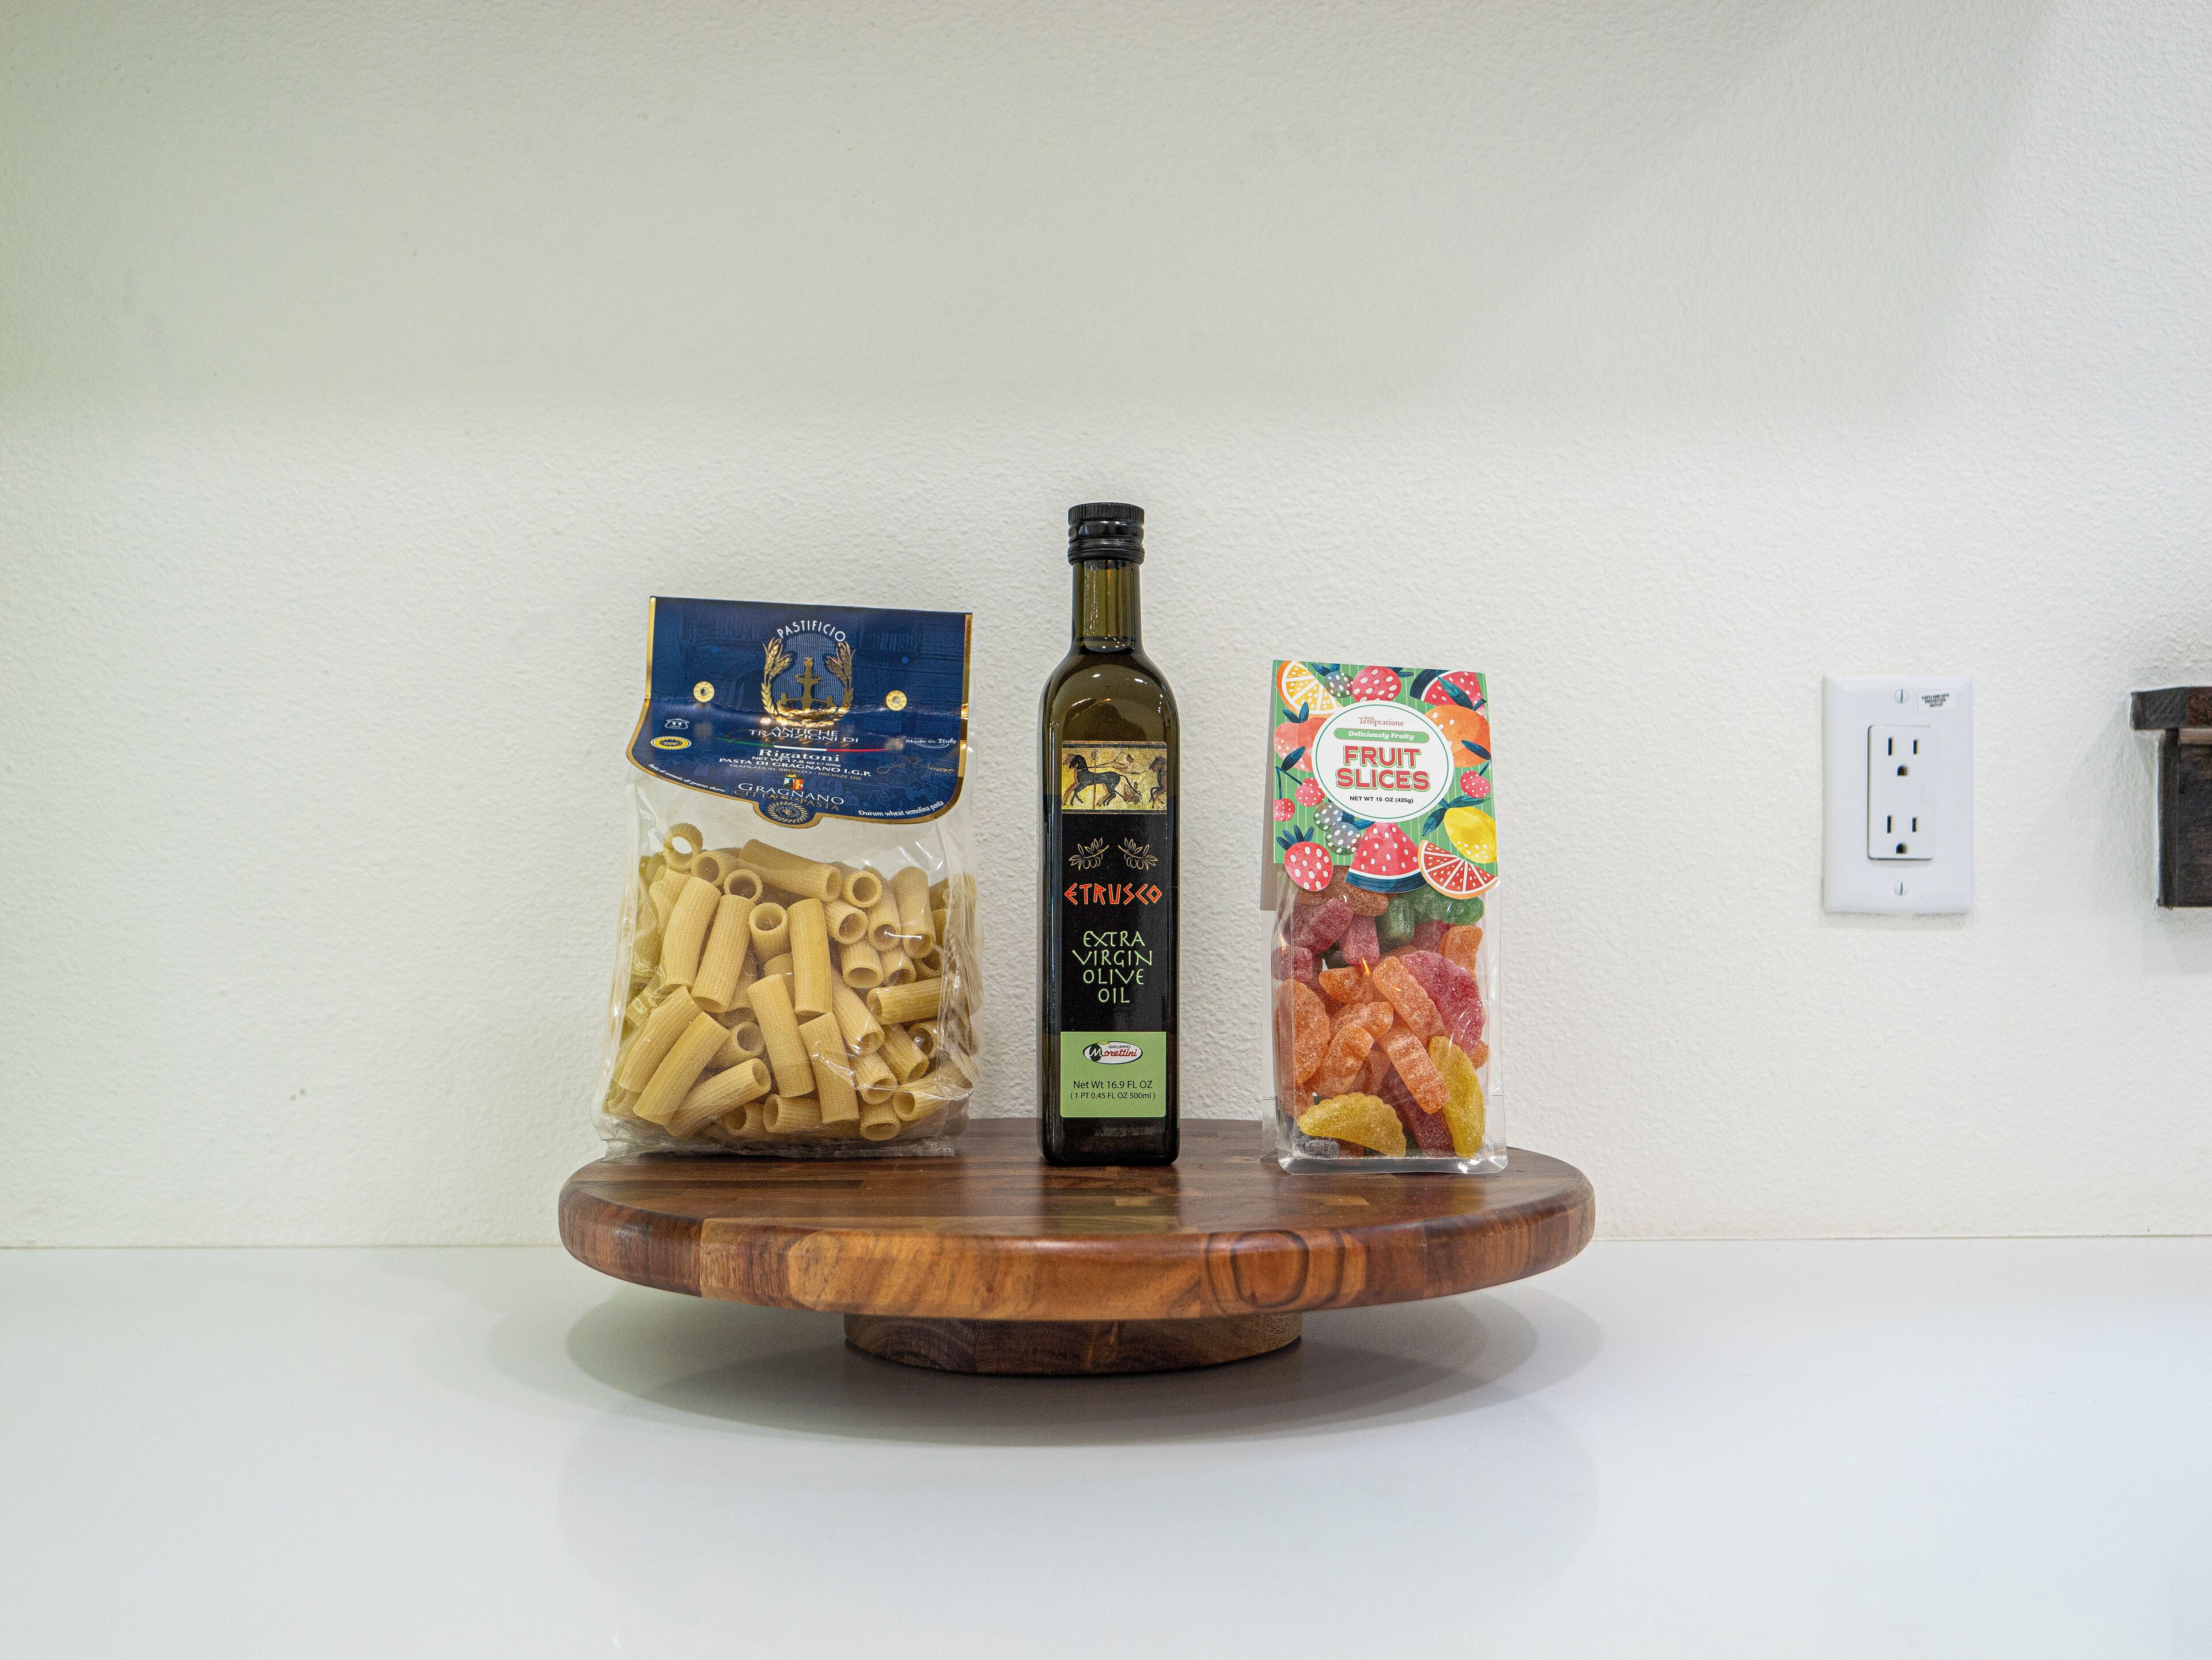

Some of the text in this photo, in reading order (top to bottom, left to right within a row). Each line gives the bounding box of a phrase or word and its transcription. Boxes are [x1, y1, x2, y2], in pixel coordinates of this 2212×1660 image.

[777, 620, 846, 642] PASTIFICIO
[1358, 717, 1404, 726] Temptations
[748, 729, 838, 741] TRADIZIONI
[771, 726, 838, 737] ANTICHE
[1349, 730, 1415, 741] Deliciously Fruity
[757, 749, 840, 762] Rigatoni
[1344, 745, 1421, 768] FRUIT
[772, 761, 841, 773] GRAGNANO
[844, 768, 872, 776] I.G.P.
[1336, 767, 1431, 792] SLICES
[738, 783, 844, 805] GRAGNANO
[800, 798, 839, 811] PASTA
[905, 806, 930, 815] semolina
[930, 801, 944, 811] pasta
[1065, 883, 1162, 905] ETRUSCO
[1083, 931, 1146, 947] EXTRA
[1072, 949, 1152, 967] VIRGIN
[1083, 968, 1145, 985] OLIVE
[1098, 987, 1130, 1003] OIL
[1089, 1048, 1138, 1057] Morettini
[1073, 1081, 1153, 1089] Net Wt 16.9 FL OZ
